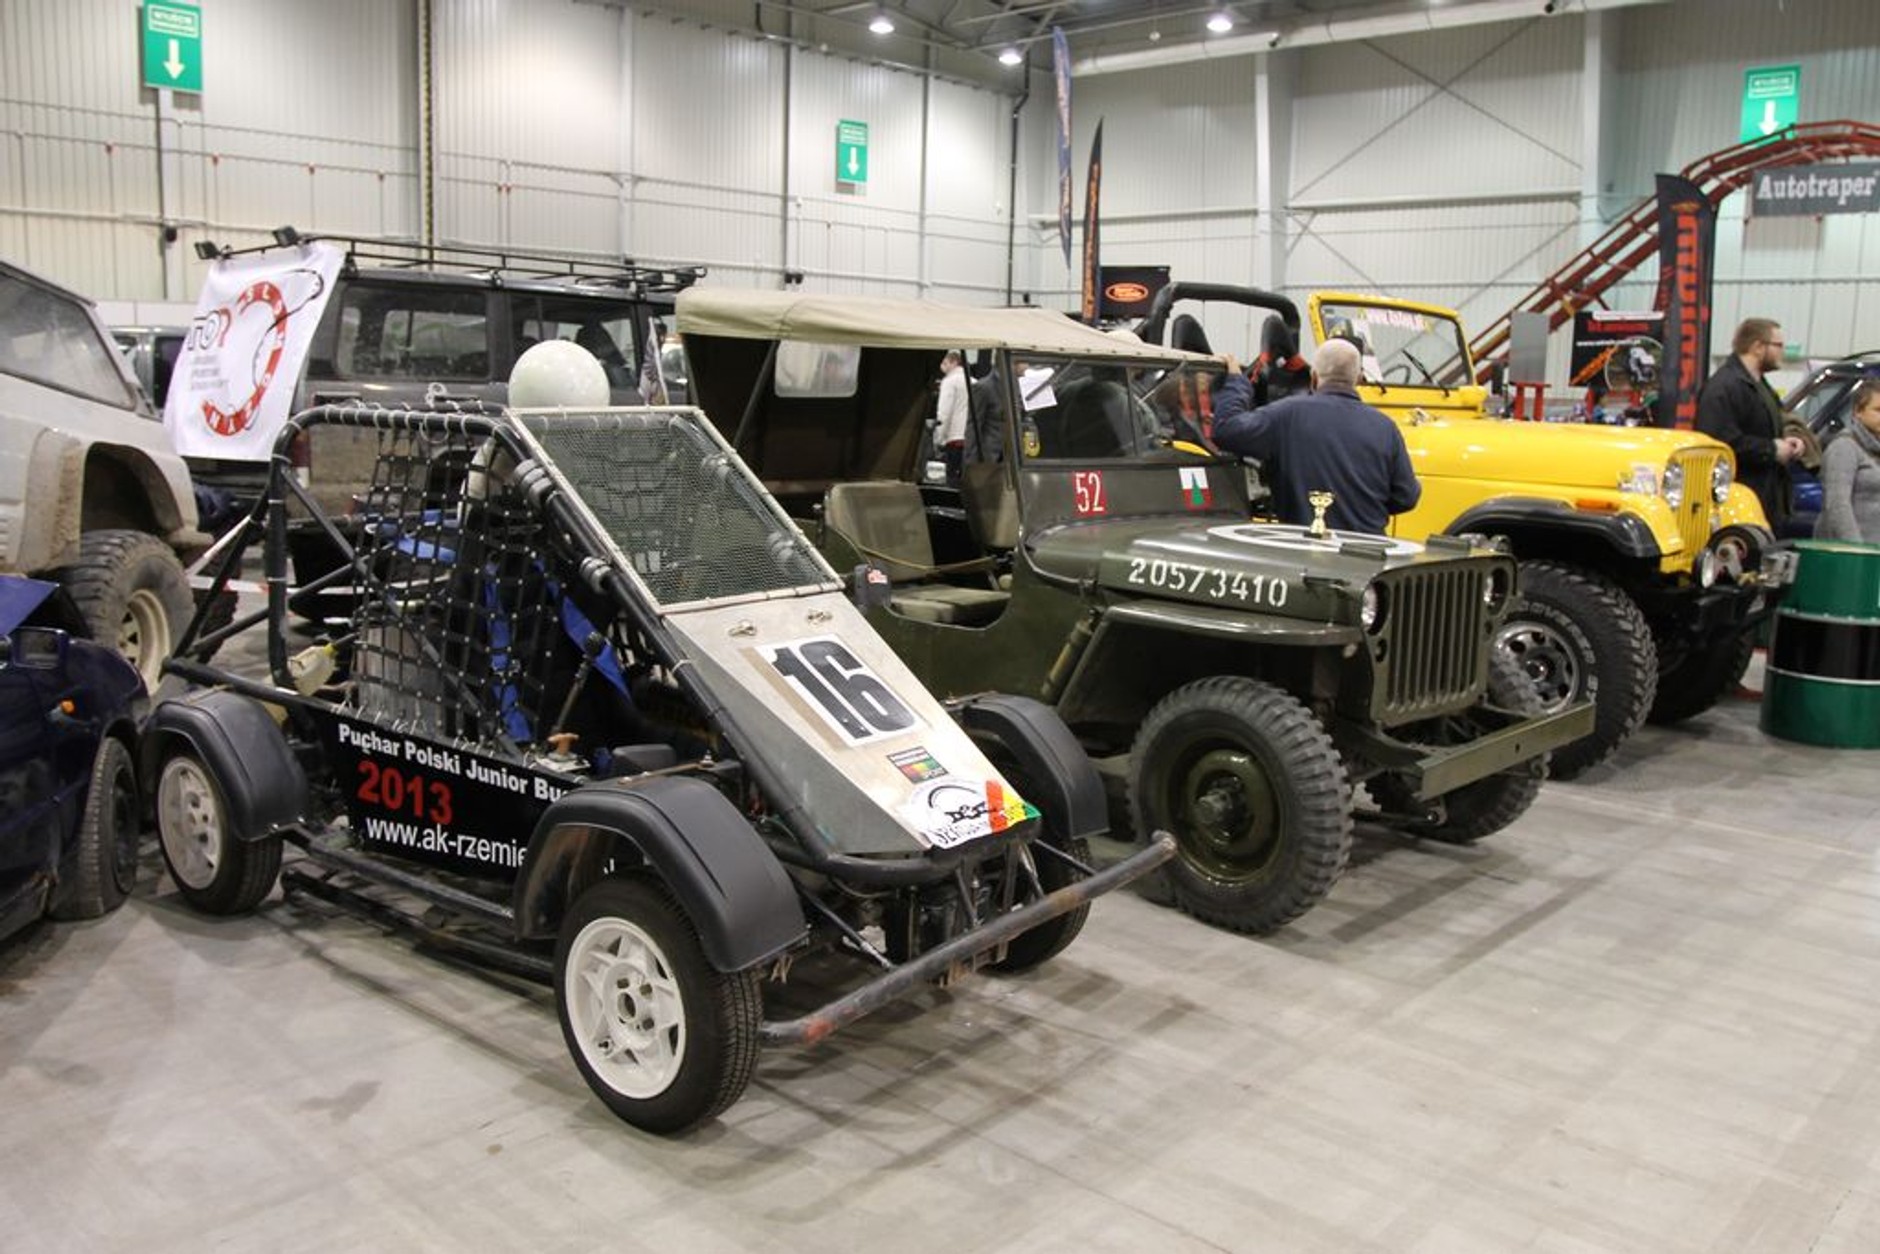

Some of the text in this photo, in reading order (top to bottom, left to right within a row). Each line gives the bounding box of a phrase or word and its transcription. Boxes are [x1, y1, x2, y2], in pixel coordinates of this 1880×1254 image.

[1757, 174, 1877, 205] Autotraper
[1075, 471, 1104, 513] 52
[1128, 557, 1289, 607] 20573410
[771, 640, 915, 739] 16
[338, 723, 569, 803] Puchar Polski Junior Bu
[357, 760, 453, 825] 2013
